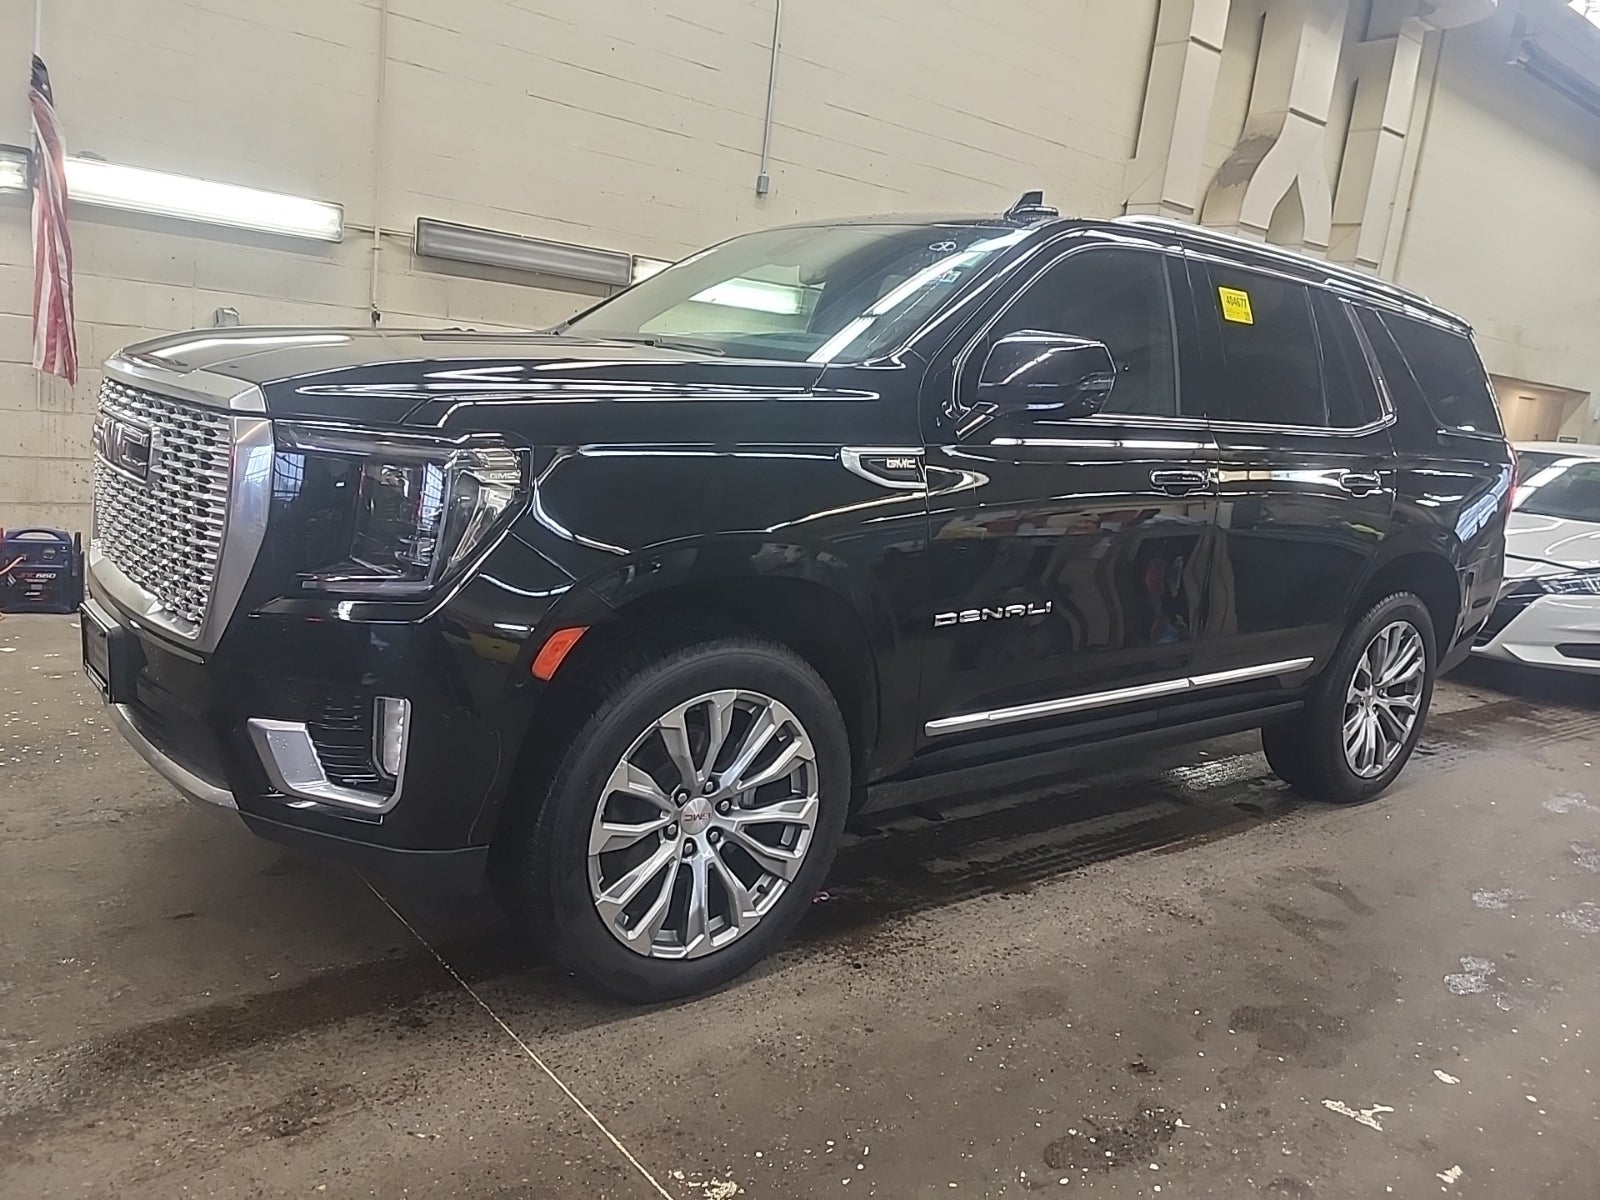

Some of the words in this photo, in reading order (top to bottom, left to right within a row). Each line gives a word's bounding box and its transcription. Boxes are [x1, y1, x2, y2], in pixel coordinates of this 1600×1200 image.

[886, 457, 917, 469] GMC
[934, 600, 1053, 627] DENALI
[684, 812, 711, 822] GMC
